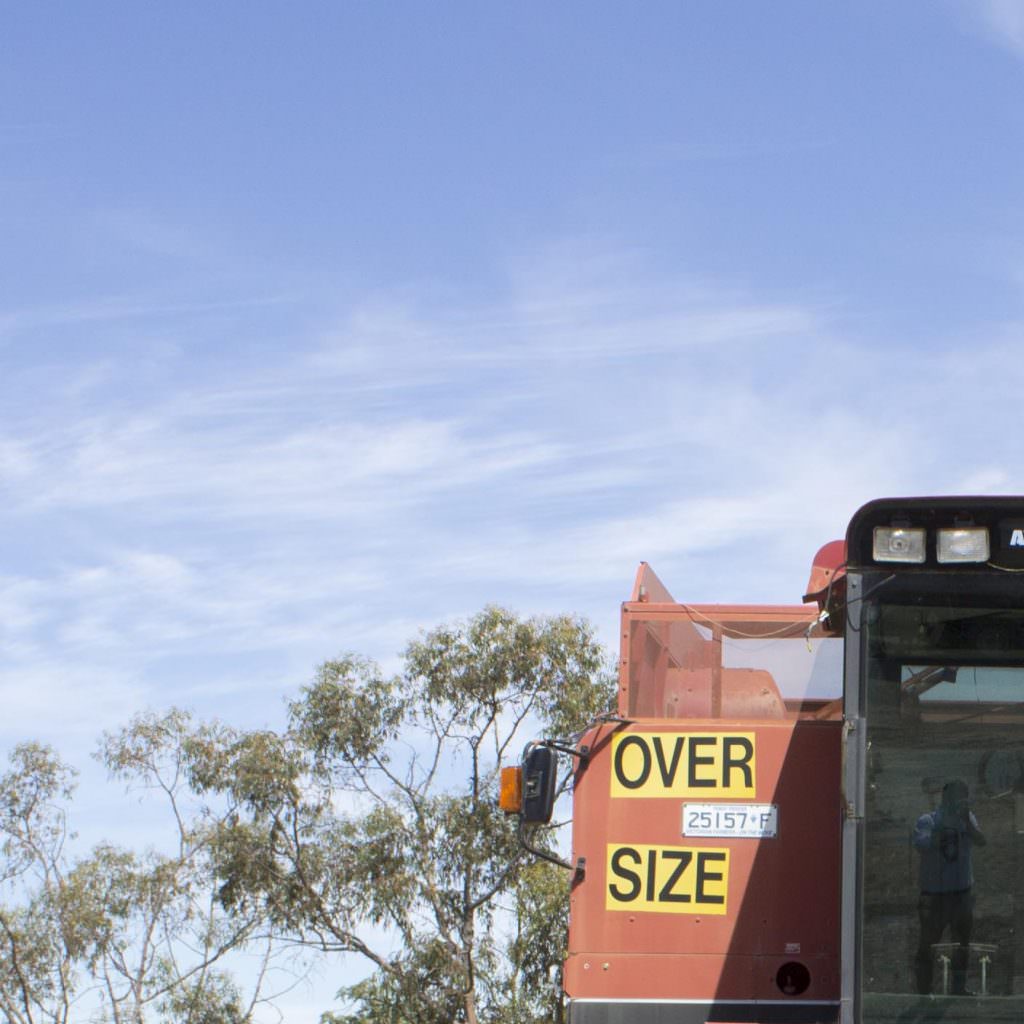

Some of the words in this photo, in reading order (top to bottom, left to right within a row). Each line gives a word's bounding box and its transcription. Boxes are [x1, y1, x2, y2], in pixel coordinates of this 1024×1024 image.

[614, 735, 754, 789] OVER
[688, 812, 747, 829] 25157
[759, 813, 772, 829] F
[609, 847, 726, 904] SIZE
